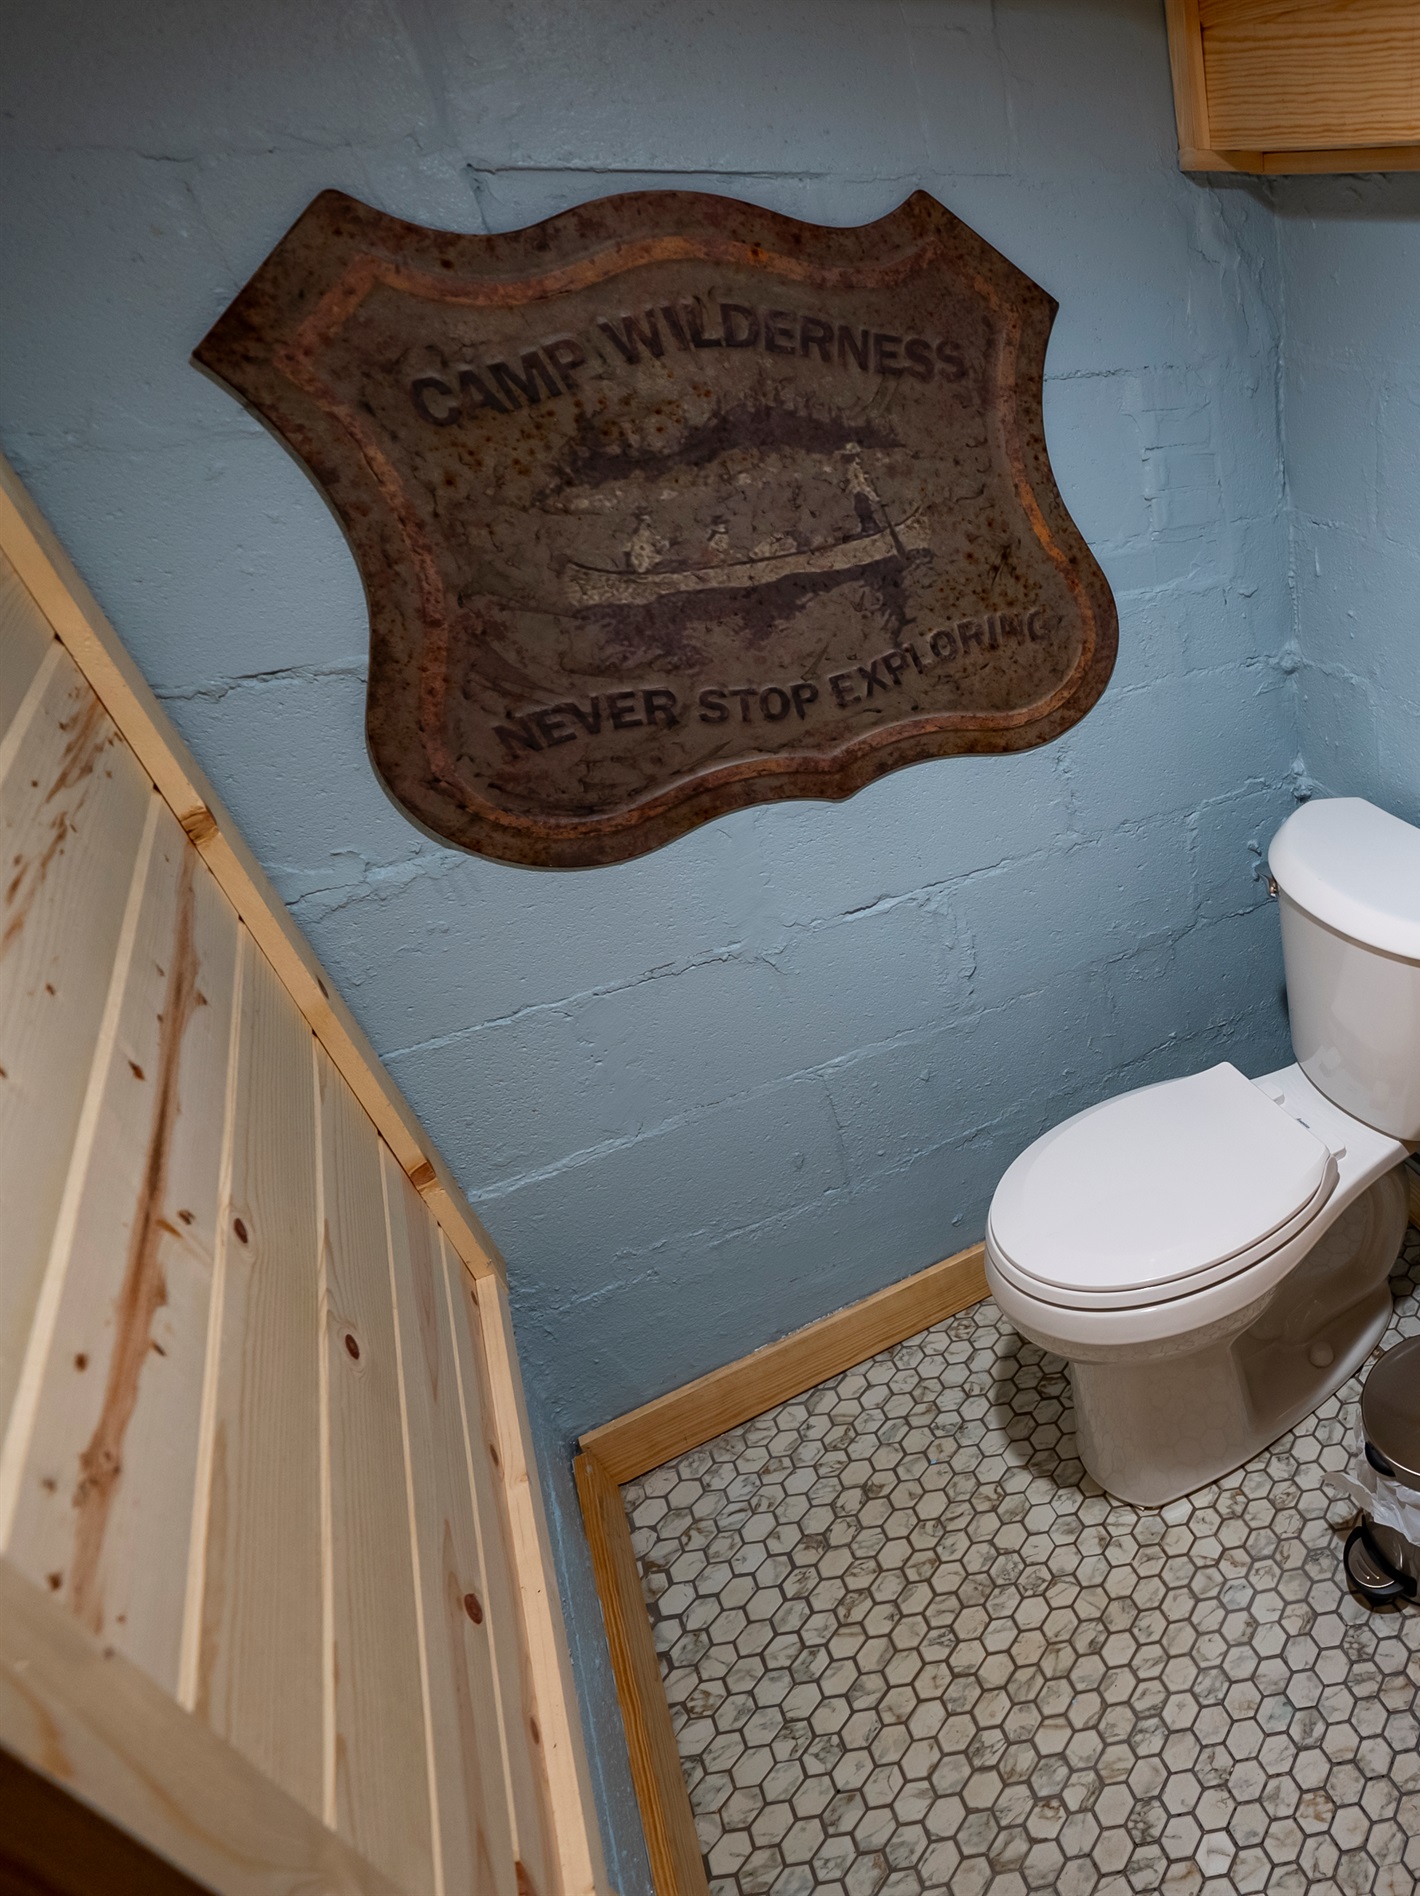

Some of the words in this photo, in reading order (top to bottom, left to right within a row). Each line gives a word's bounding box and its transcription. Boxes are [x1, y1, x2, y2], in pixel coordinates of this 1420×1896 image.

[410, 337, 587, 427] CAMP
[597, 299, 967, 383] WILDERNESS
[493, 688, 680, 762] NEVER
[699, 682, 819, 723] STOP
[828, 608, 1051, 708] EXPLORING
